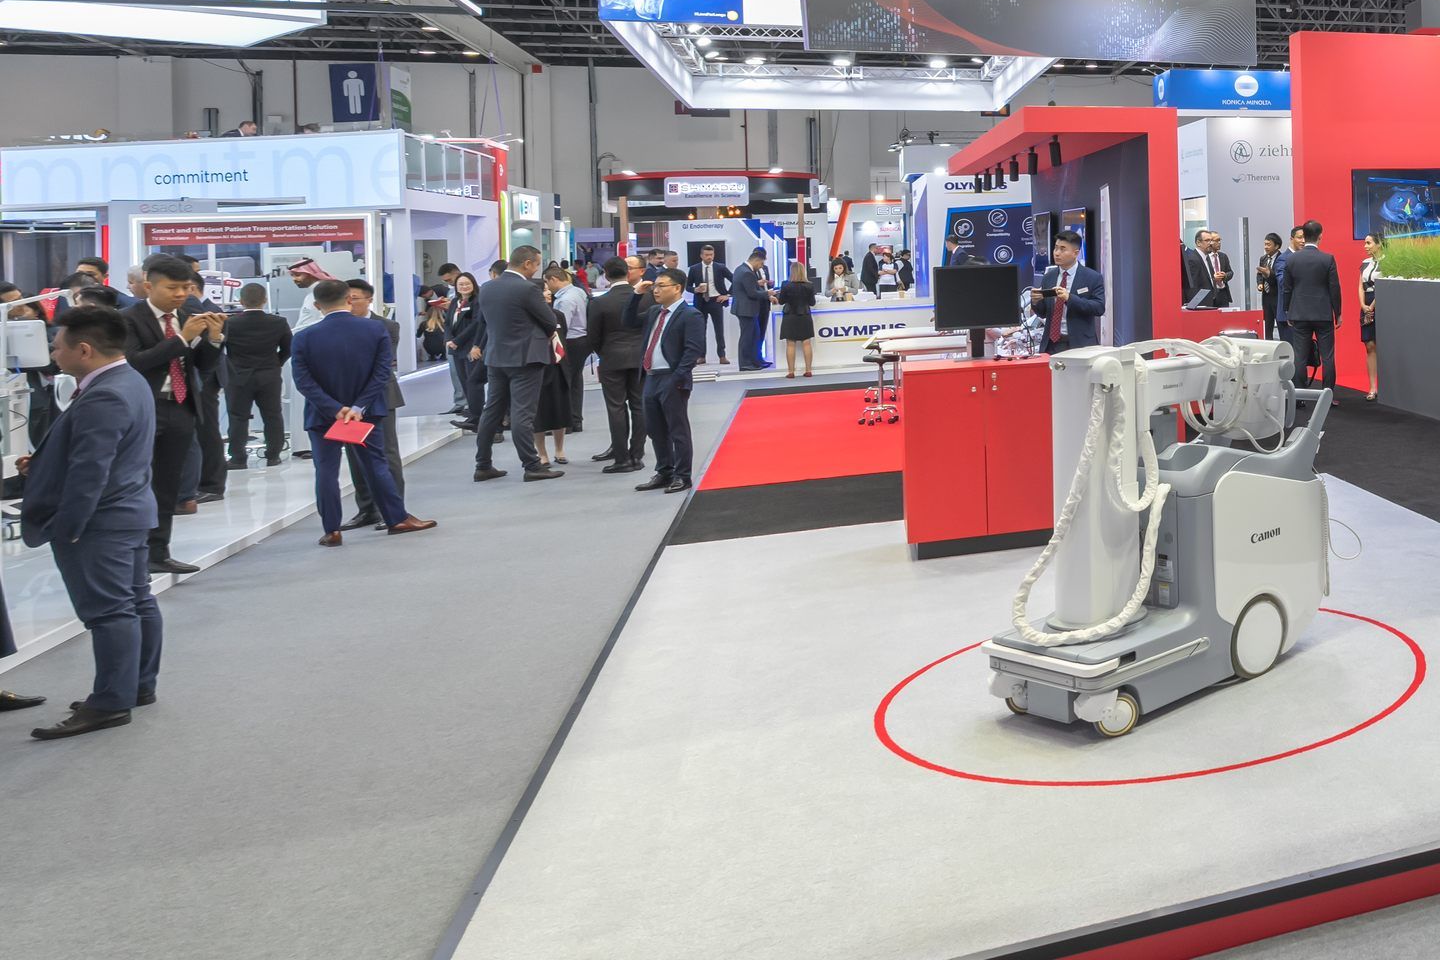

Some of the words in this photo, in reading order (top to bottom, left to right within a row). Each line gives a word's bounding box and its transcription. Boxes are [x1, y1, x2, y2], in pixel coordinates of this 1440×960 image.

[153, 168, 249, 186] commitment
[1247, 173, 1280, 182] Therenva
[680, 183, 745, 192] SHIMADZU
[139, 202, 193, 214] esaote
[252, 224, 307, 232] Transportation
[1250, 526, 1281, 544] Canon
